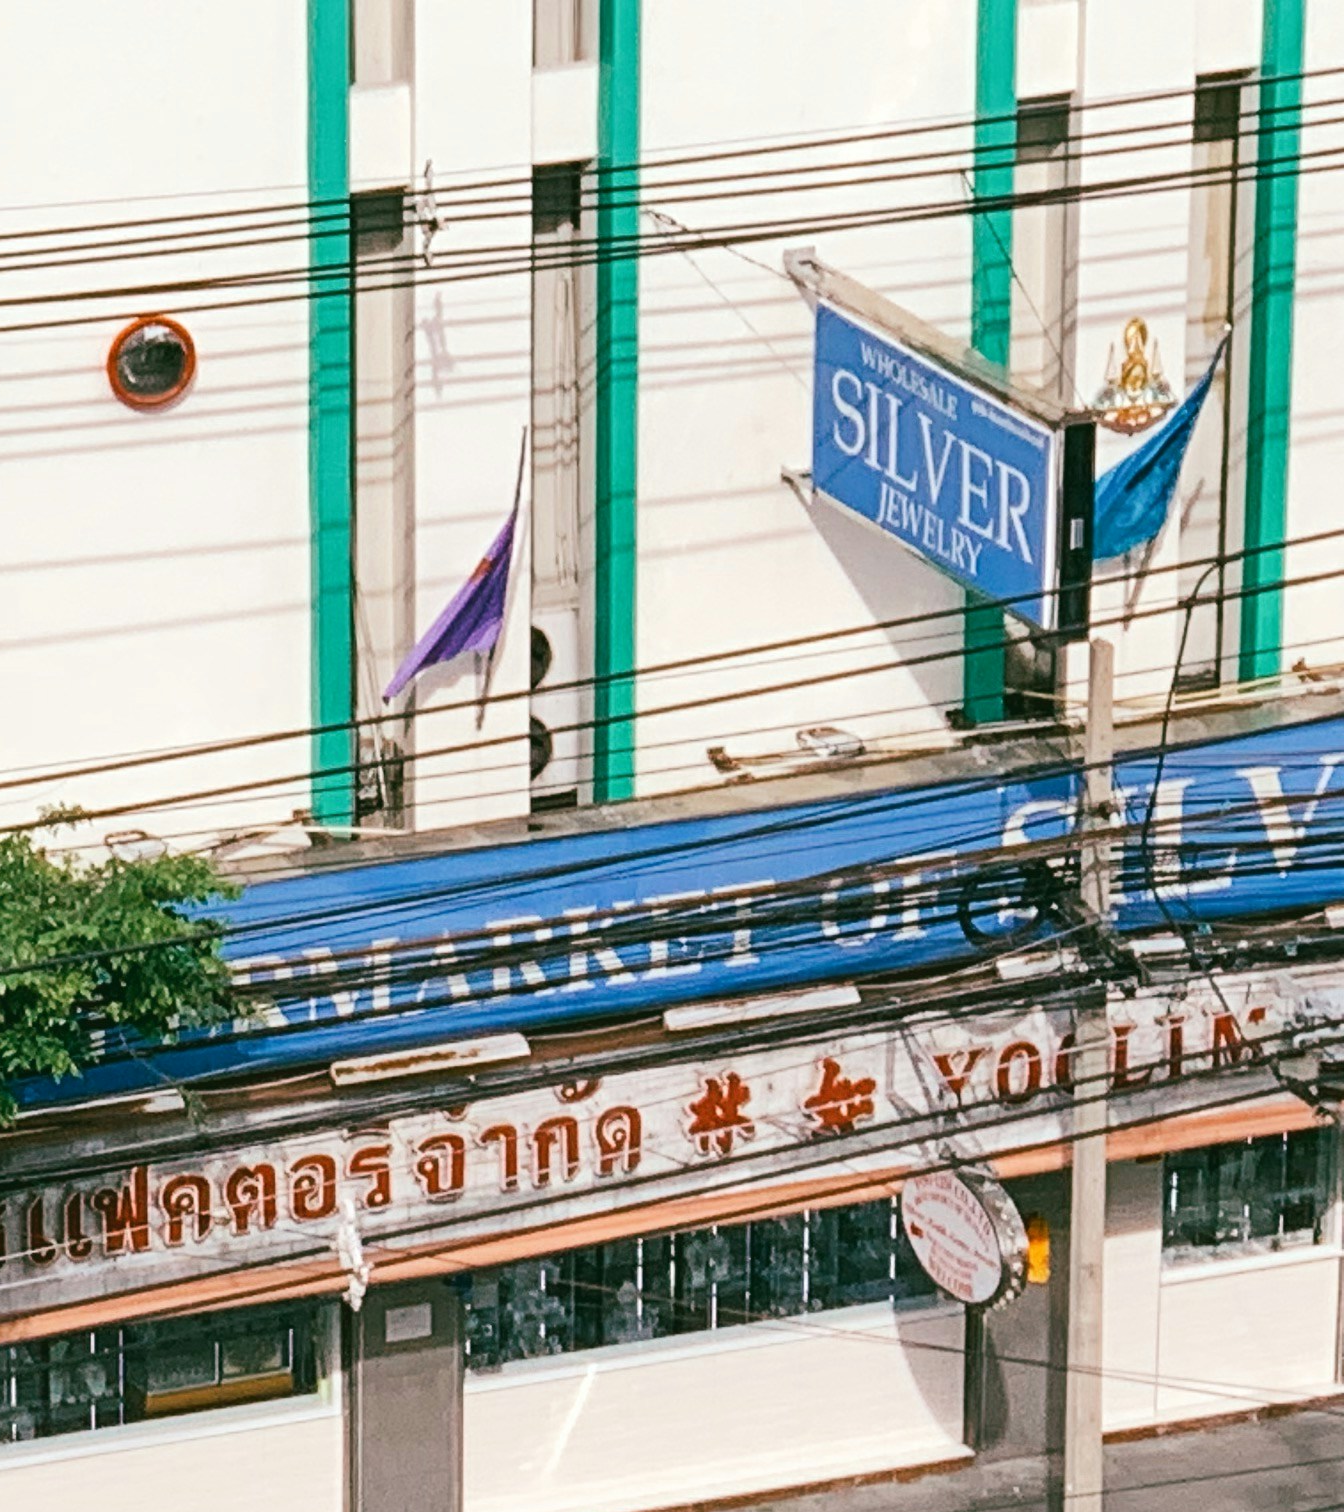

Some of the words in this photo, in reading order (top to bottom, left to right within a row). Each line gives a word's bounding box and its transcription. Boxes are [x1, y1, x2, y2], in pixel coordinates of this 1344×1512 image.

[861, 342, 958, 421] WHOLESALE
[832, 369, 1034, 565] SILVER
[876, 481, 982, 577] JEWELRY
